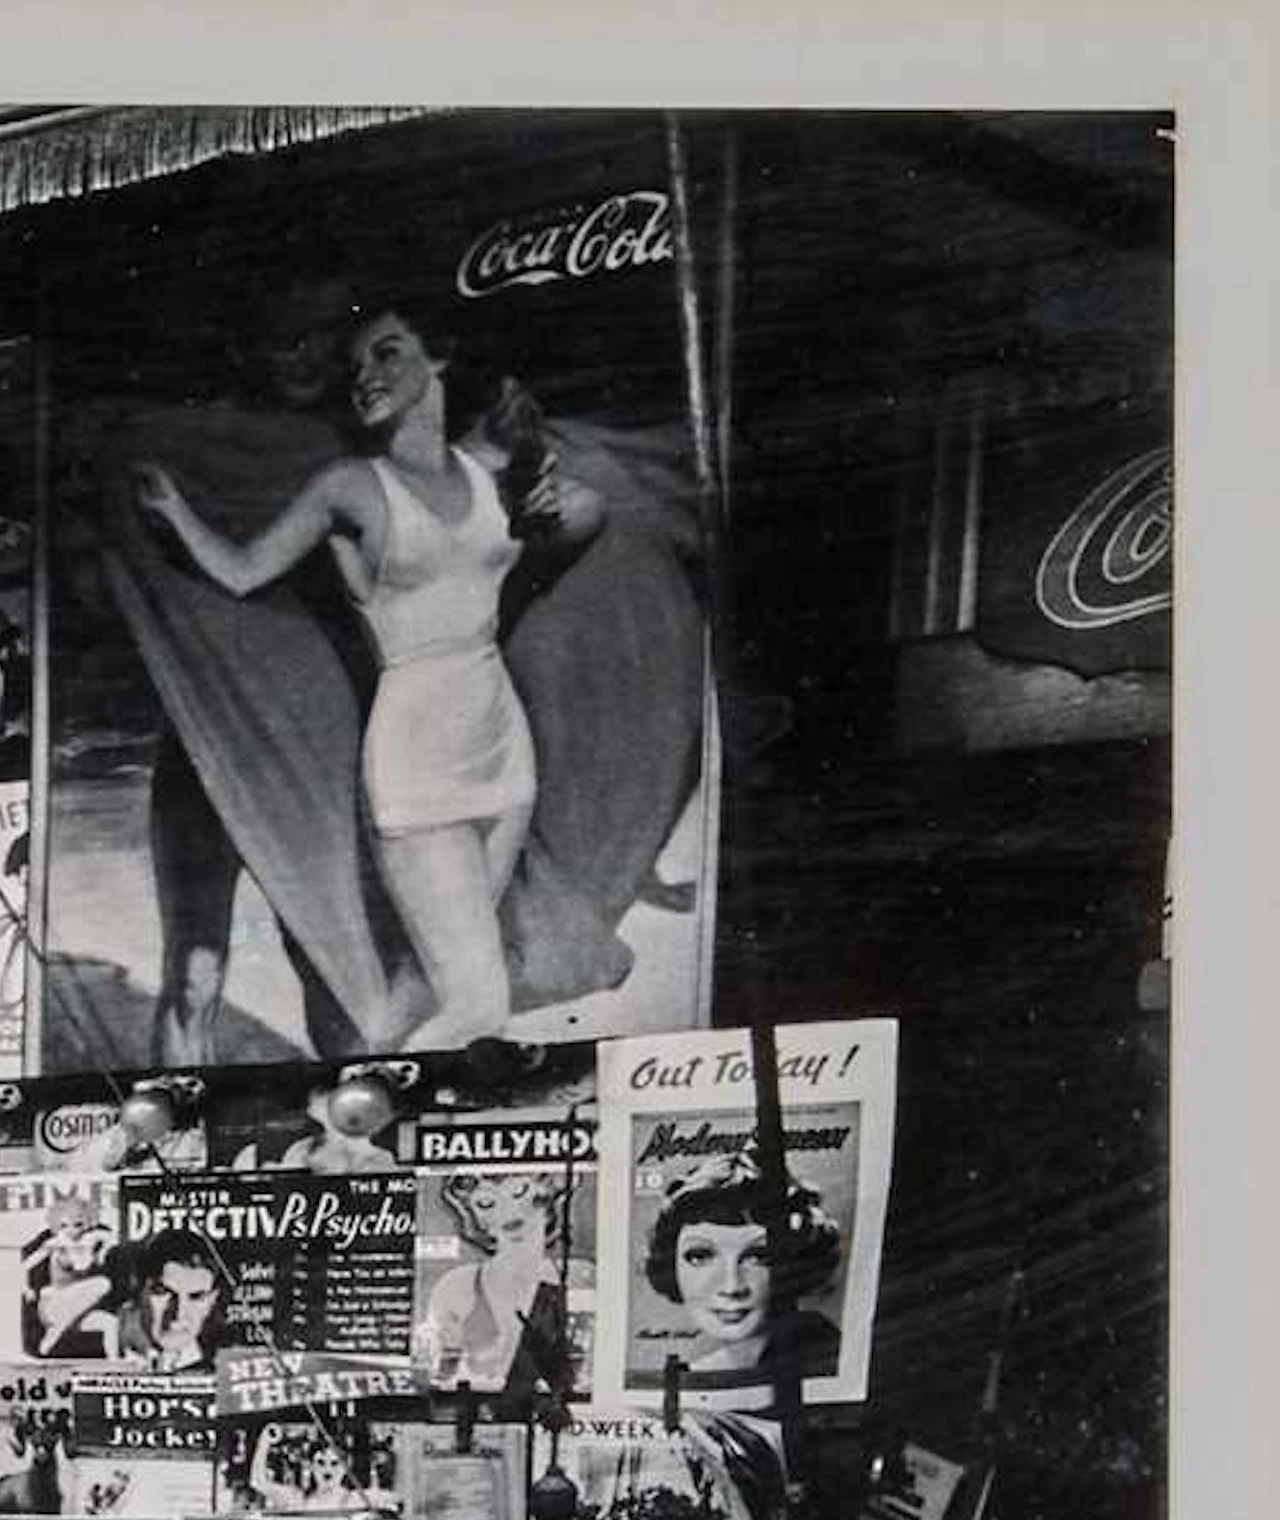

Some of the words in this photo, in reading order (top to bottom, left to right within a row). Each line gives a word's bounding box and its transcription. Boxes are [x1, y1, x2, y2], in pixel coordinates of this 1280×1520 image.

[630, 1056, 698, 1091] Out
[423, 1123, 598, 1161] BALLYHO
[230, 1370, 417, 1412] THEATRE
